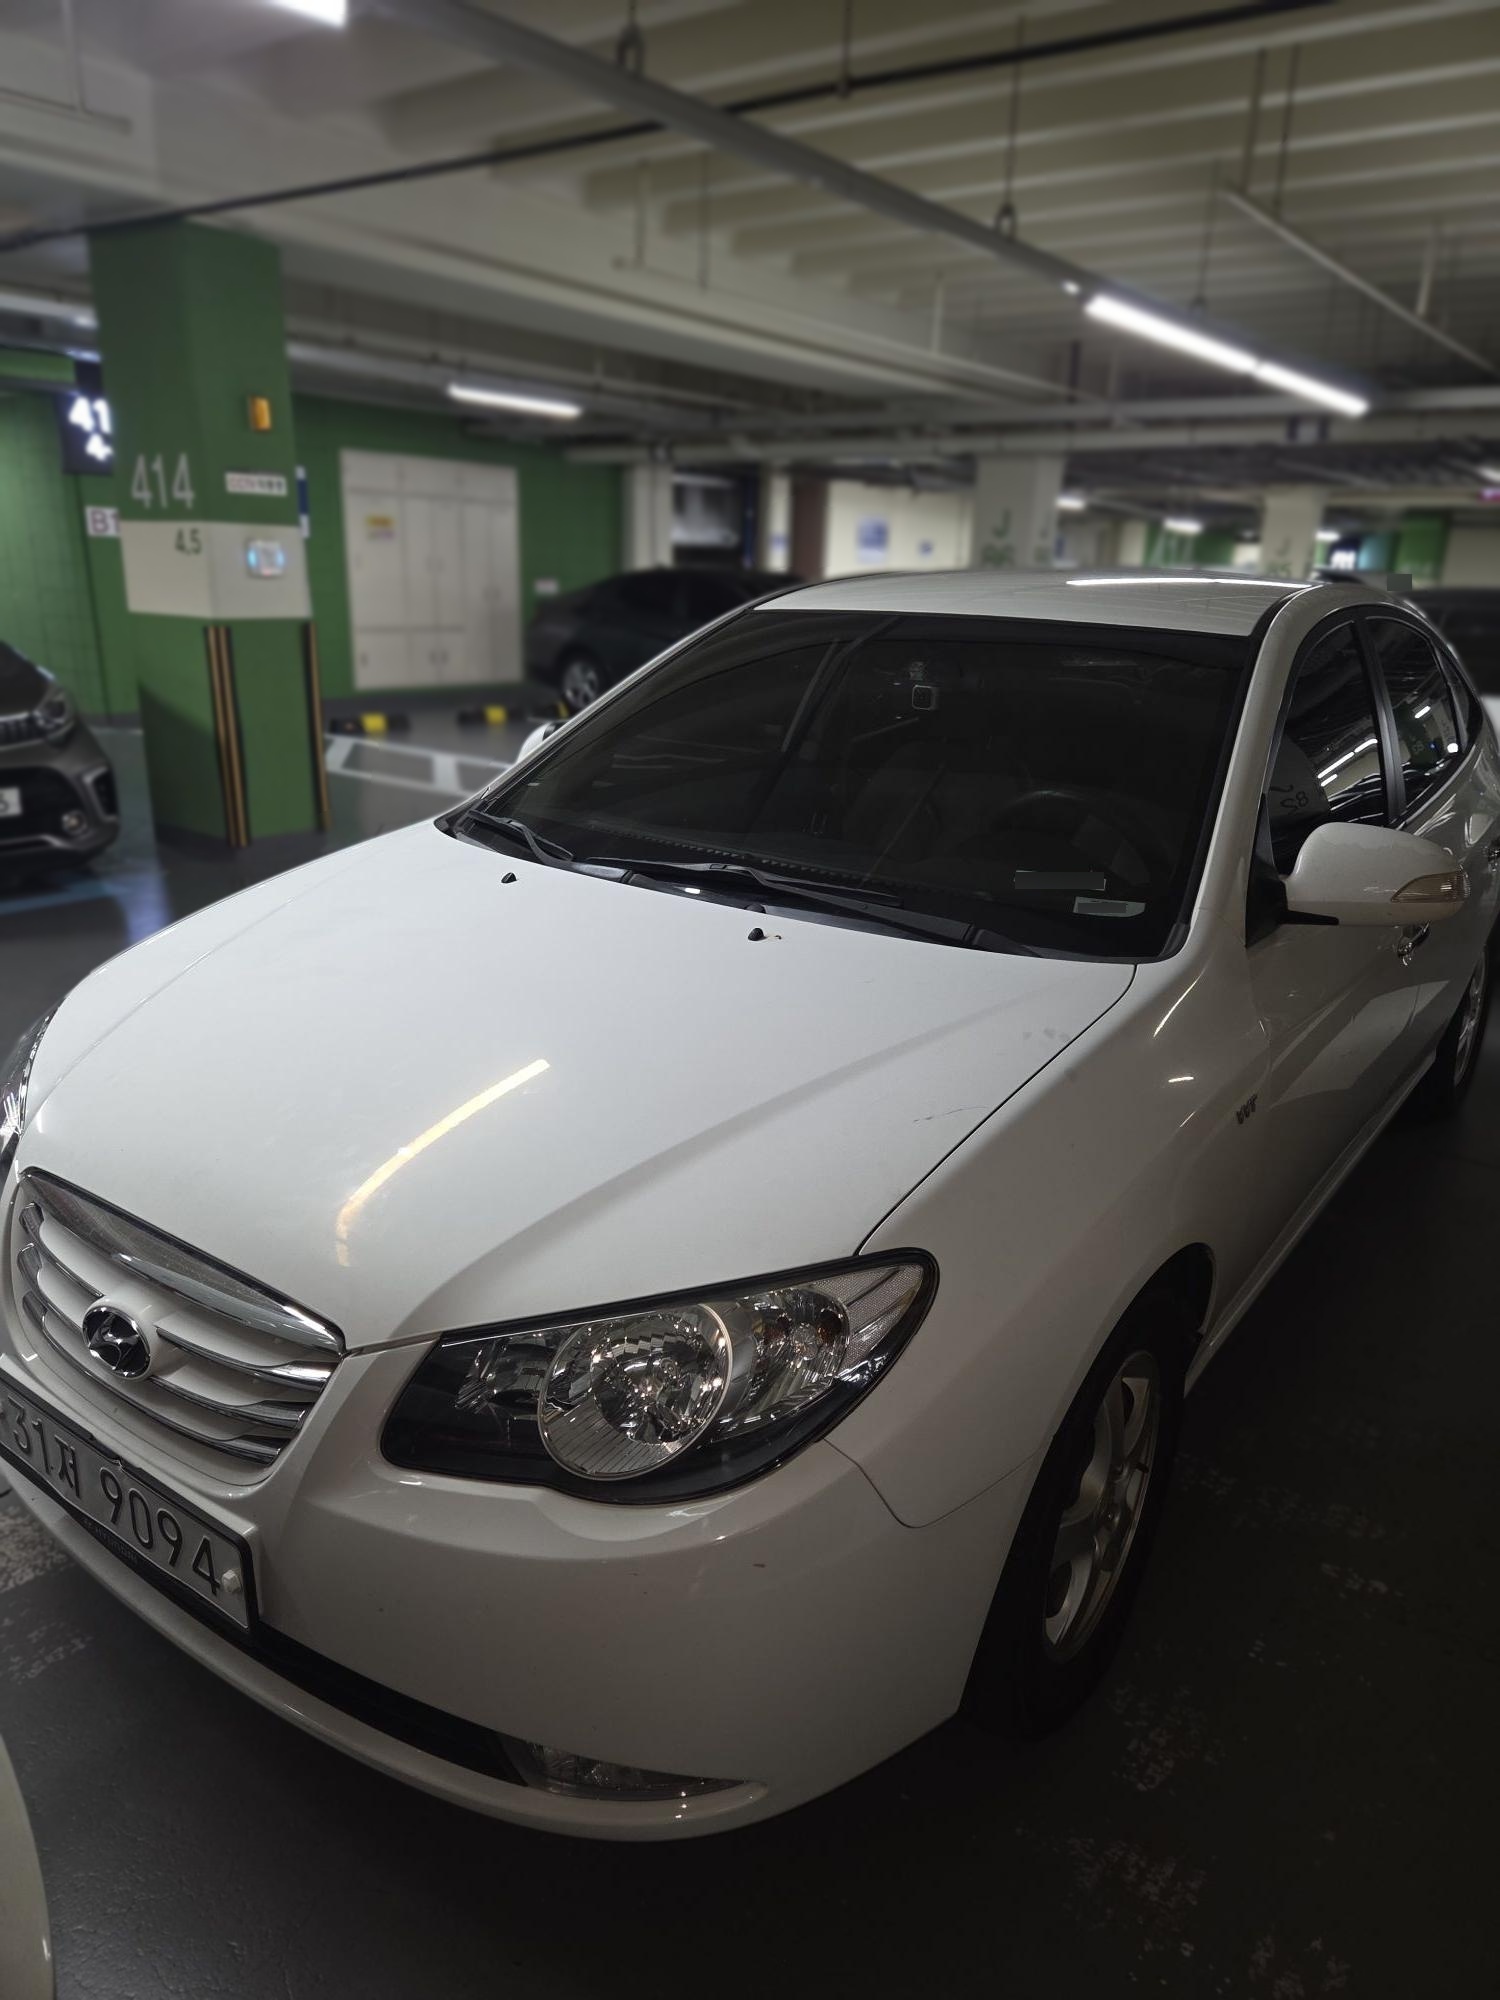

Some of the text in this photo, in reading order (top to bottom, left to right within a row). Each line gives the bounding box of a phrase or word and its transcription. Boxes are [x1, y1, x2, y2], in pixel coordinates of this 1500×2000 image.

[131, 453, 195, 509] 414
[91, 509, 121, 535] B1
[100, 1466, 220, 1596] 9094
